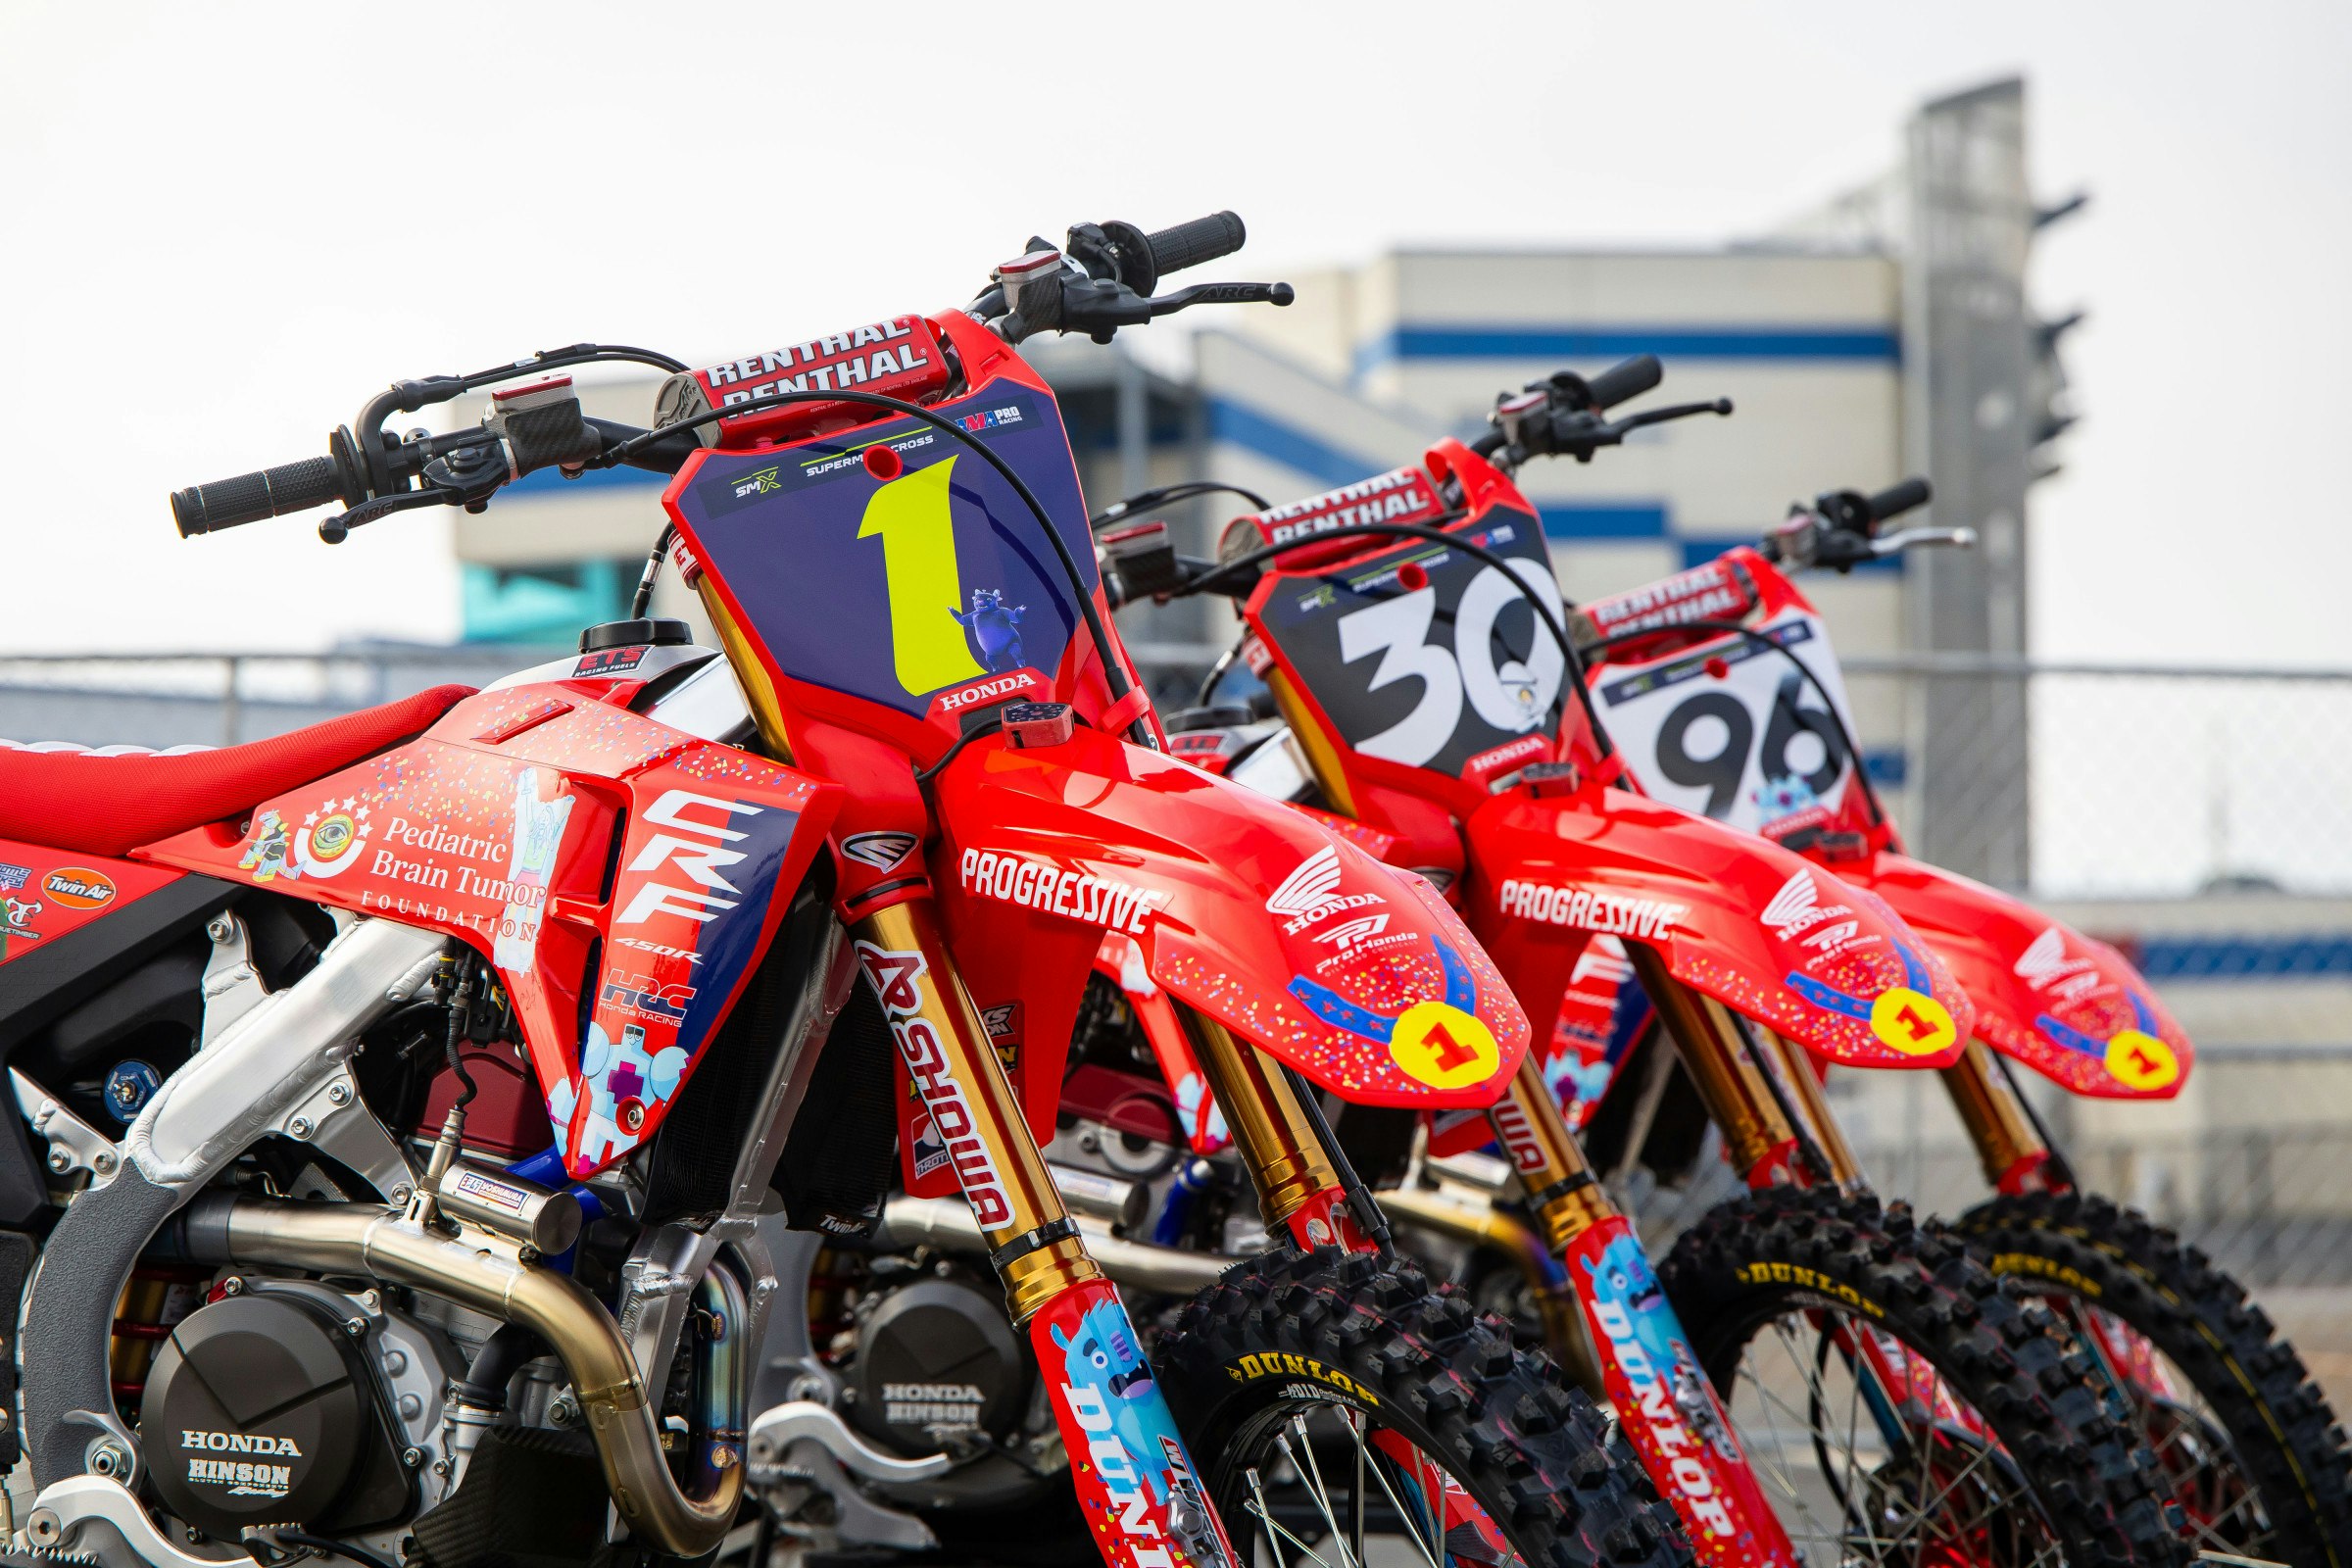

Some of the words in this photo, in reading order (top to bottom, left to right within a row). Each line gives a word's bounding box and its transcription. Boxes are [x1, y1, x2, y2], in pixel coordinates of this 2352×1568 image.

[1200, 283, 1256, 299] ARC
[706, 319, 912, 387] RENTHAL
[723, 344, 928, 419] RENTHAL
[955, 411, 998, 432] AMA
[996, 406, 1019, 419] PRO
[998, 416, 1022, 425] RACING
[807, 434, 934, 477] SUPERMCROSS
[736, 470, 782, 498] SMX
[1272, 489, 1430, 545] RENTHAL
[856, 454, 988, 697] 1
[574, 665, 608, 677] RACING
[579, 646, 646, 670] ETS
[1338, 558, 1566, 767] 30
[940, 673, 1036, 711] HONDA
[1473, 736, 1544, 773] HONDA
[1656, 670, 1843, 817] 96
[383, 816, 507, 863] Pediatric
[615, 789, 764, 923] CRF
[48, 875, 86, 896] Twin
[84, 884, 113, 900] Air
[368, 849, 447, 889] Brain
[455, 865, 548, 909] Tumor
[961, 847, 1163, 934] PROGRESSIVE
[361, 890, 539, 942] FOUNDATION
[1283, 893, 1388, 936] HONDA
[1500, 879, 1683, 941] PROGRESSIVE
[1776, 904, 1853, 942] HONDA
[0, 926, 40, 939] UETIMBER
[614, 937, 705, 965] 450R
[600, 967, 698, 1019] HRC
[599, 1001, 636, 1017] Honda
[637, 1010, 683, 1027] RACING
[1895, 1004, 1940, 1042] 1
[1420, 1021, 1479, 1073] 1
[2128, 1047, 2162, 1077] 1
[893, 1020, 1012, 1228] SHOWA
[883, 1384, 986, 1402] HONDA
[1239, 1351, 1380, 1406] DUNLOP
[1590, 1299, 1736, 1537] DUNLOP
[181, 1430, 302, 1456] HONDA
[188, 1458, 291, 1485] HINSON
